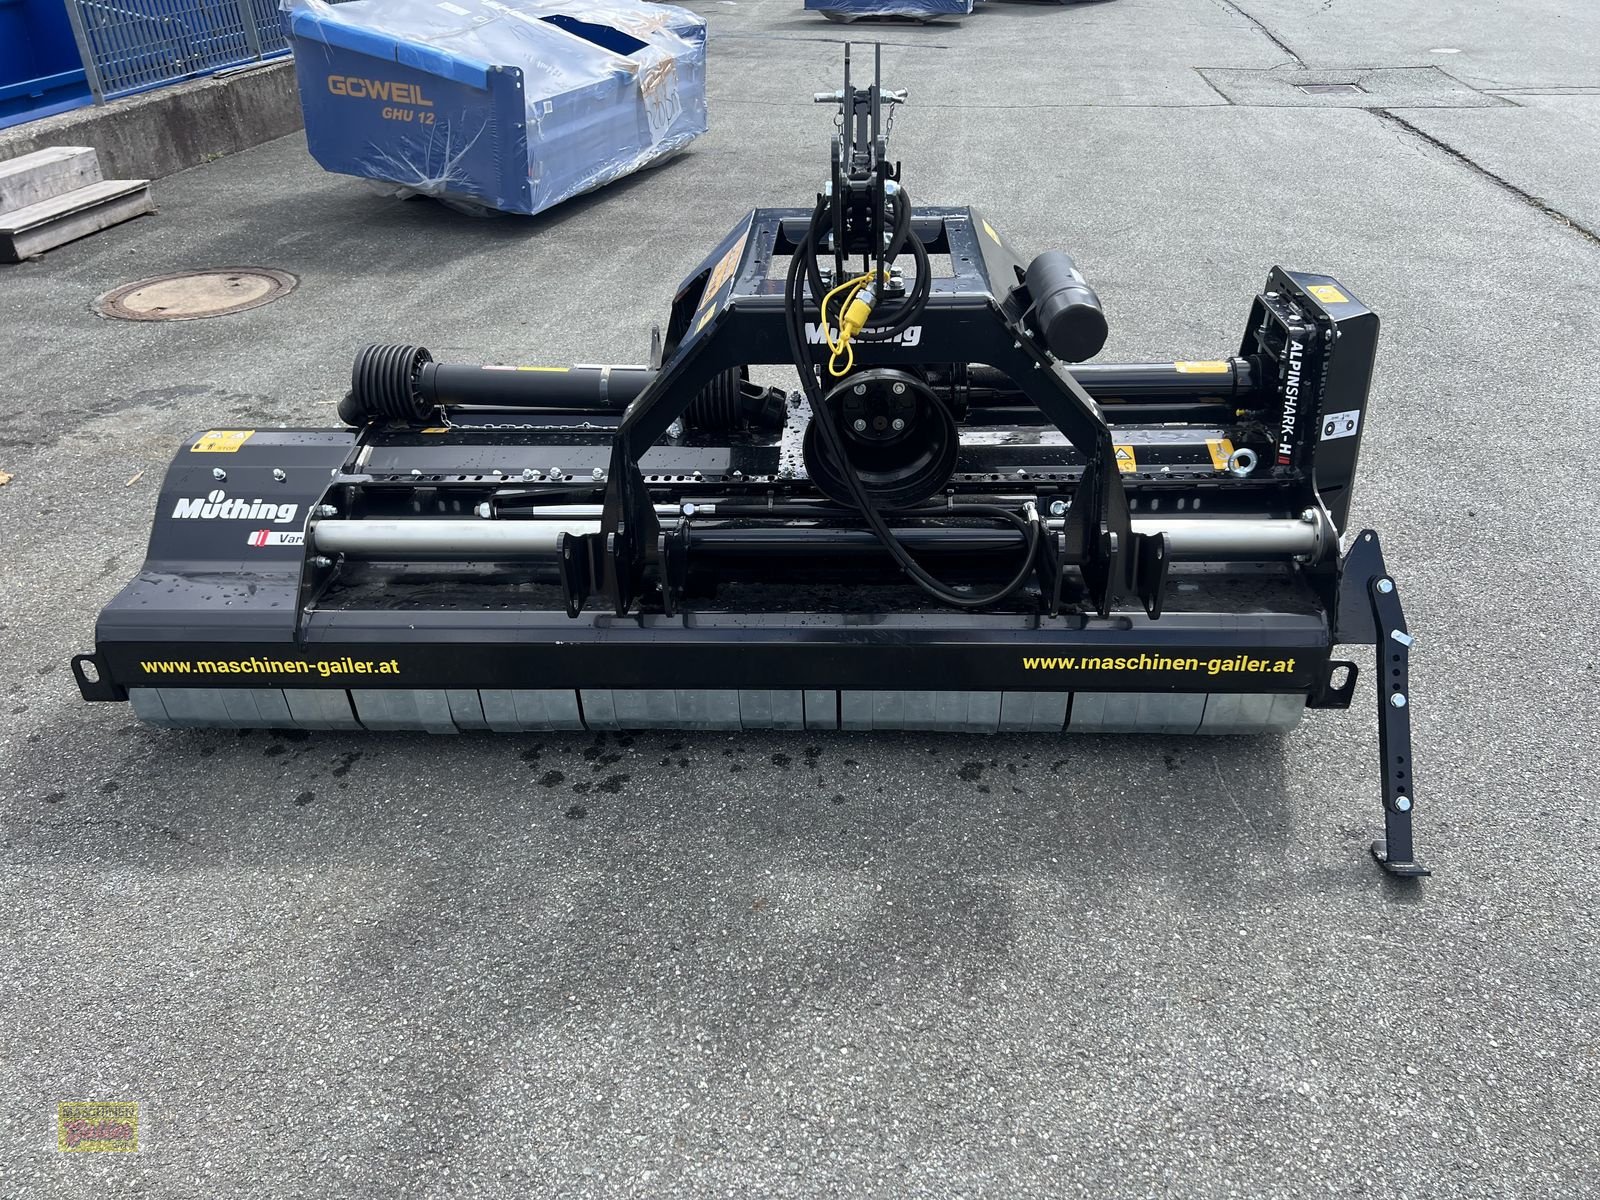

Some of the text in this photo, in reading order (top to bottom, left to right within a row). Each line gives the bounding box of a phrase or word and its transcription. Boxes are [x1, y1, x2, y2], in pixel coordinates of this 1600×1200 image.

[382, 107, 434, 124] GHU 12
[140, 657, 400, 677] www.maschinen-gailer.at
[1022, 653, 1296, 675] www.maschinen-gailer.at
